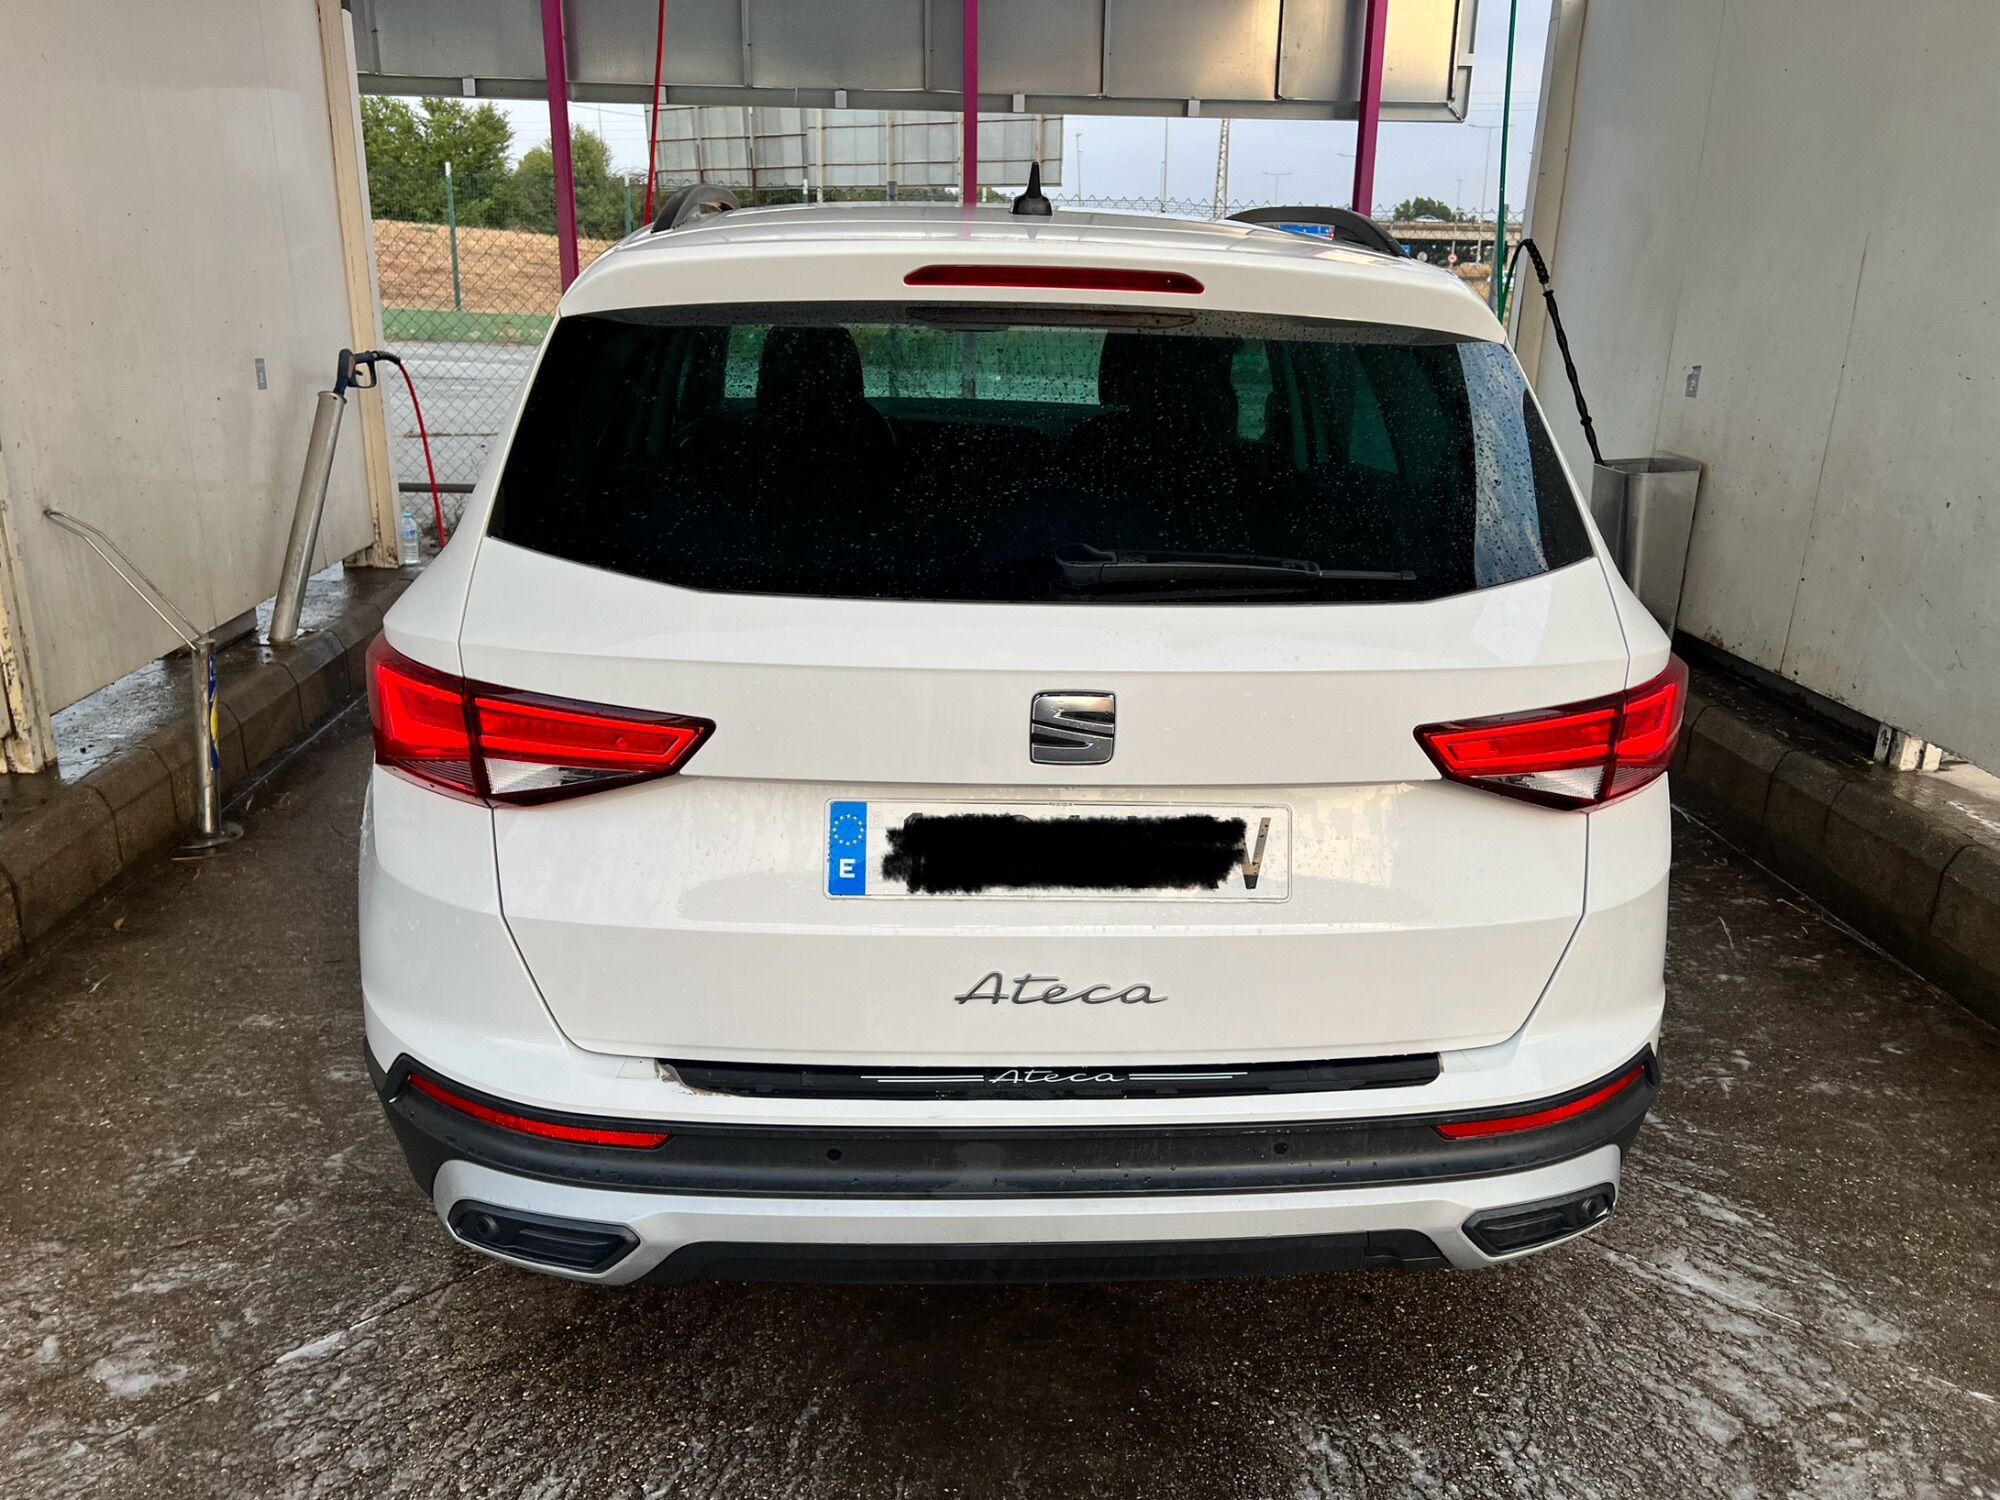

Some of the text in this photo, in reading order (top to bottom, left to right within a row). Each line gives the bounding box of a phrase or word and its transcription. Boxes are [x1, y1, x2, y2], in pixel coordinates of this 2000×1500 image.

[839, 858, 856, 878] E
[954, 970, 1168, 1004] Ateca
[988, 1069, 1125, 1084] Ateca
